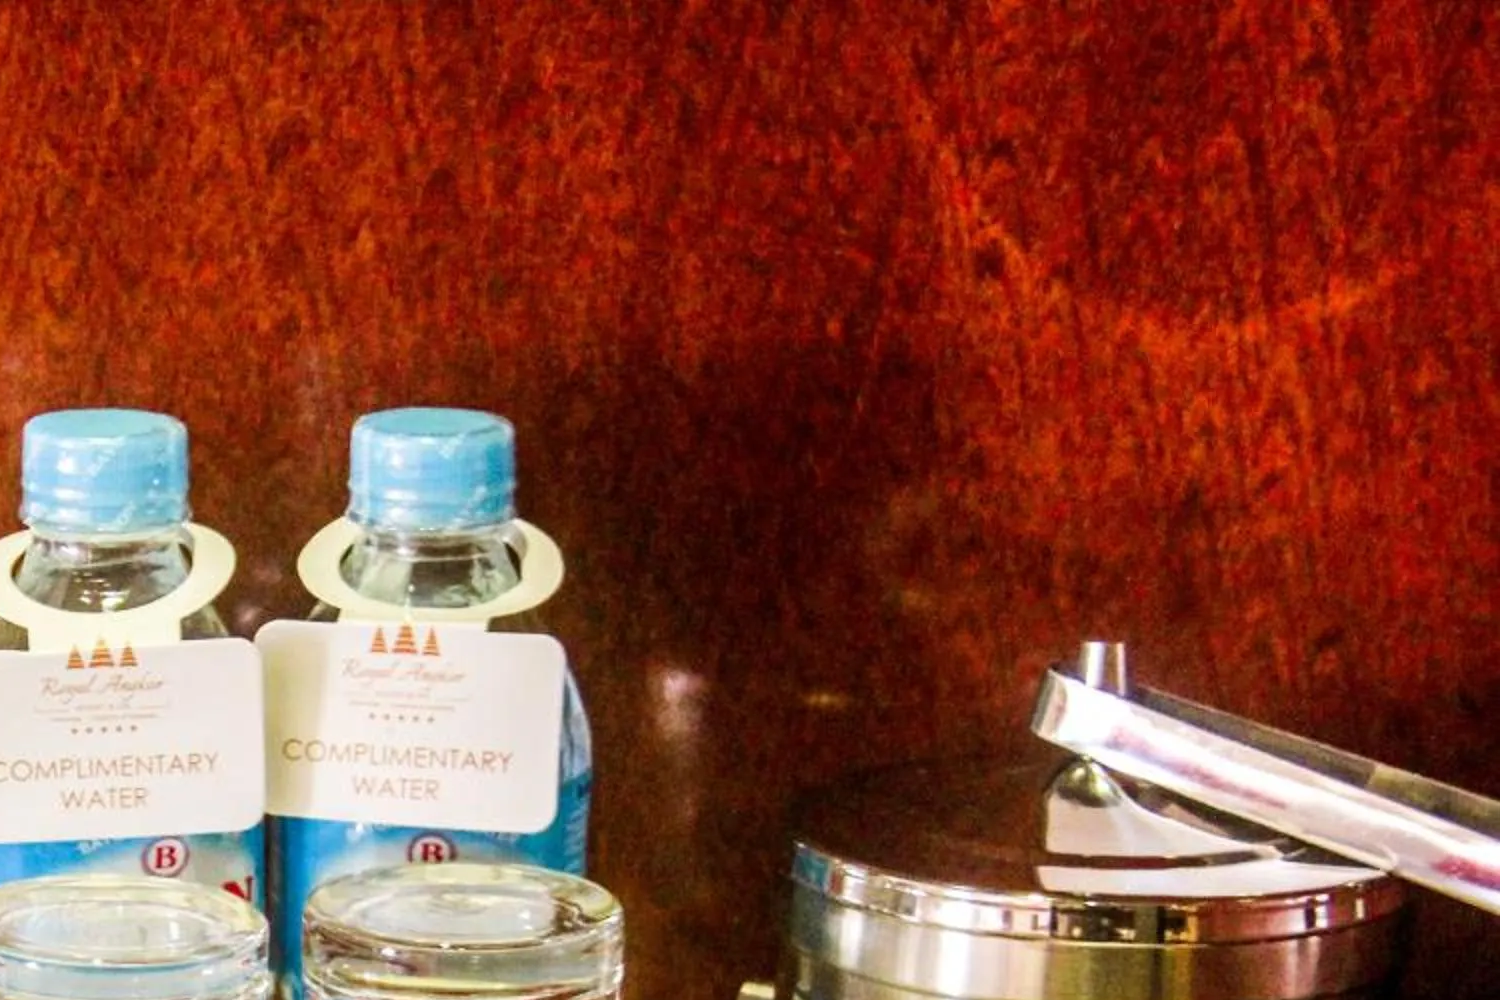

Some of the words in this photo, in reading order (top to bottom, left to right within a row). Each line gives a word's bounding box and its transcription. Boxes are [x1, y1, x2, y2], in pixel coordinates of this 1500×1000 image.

[282, 738, 514, 773] COMPLIMENTARY
[60, 787, 149, 810] WATER
[352, 776, 440, 801] WATER
[155, 846, 178, 869] B
